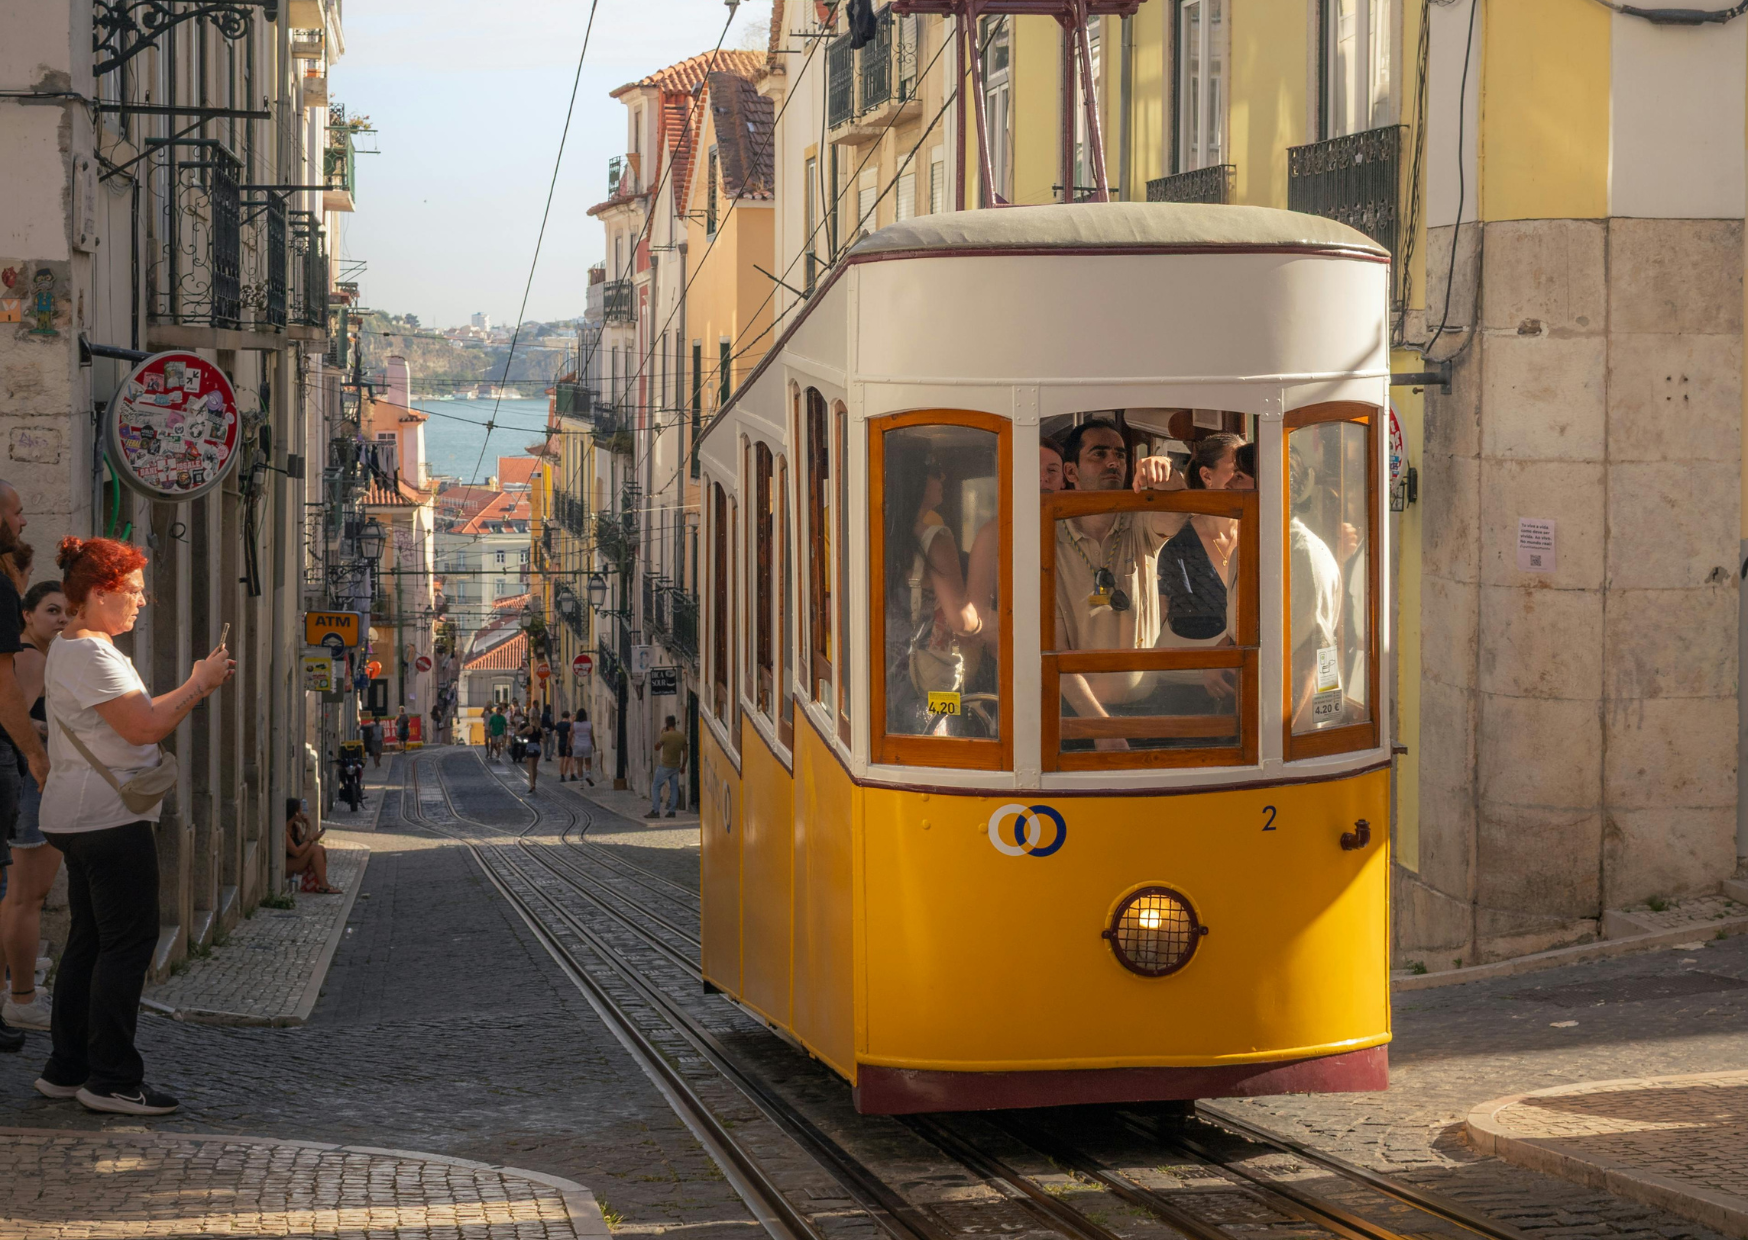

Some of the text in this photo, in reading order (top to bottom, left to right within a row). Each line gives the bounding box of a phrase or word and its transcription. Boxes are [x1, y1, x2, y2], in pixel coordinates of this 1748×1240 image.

[315, 615, 350, 628] ATM
[651, 679, 666, 687] SOUR
[1335, 702, 1340, 711] €
[1262, 805, 1277, 831] 2
